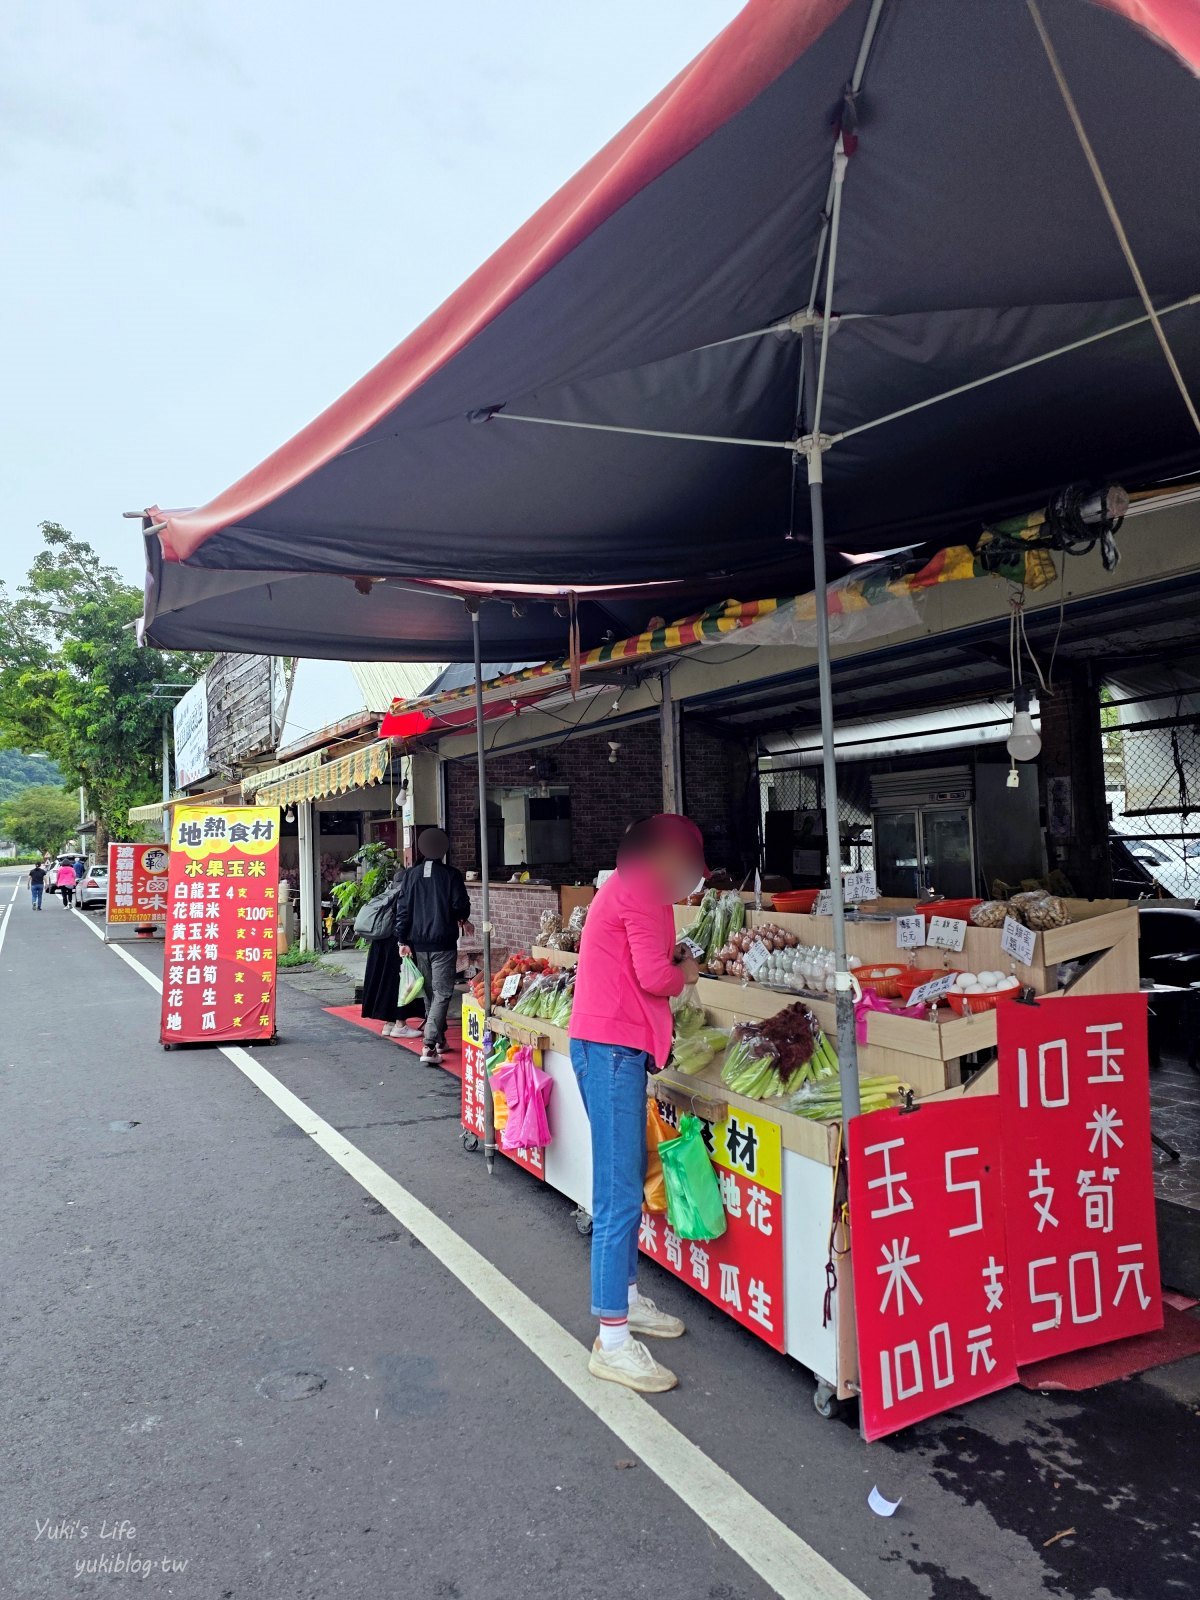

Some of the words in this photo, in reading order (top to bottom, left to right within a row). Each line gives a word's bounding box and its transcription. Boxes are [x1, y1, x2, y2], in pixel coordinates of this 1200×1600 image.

[179, 816, 274, 846] 地熱食材
[185, 860, 266, 878] 水果玉米
[174, 882, 221, 900] 白龍王
[173, 902, 220, 919] 花糯米
[170, 944, 218, 962] 玉米筍
